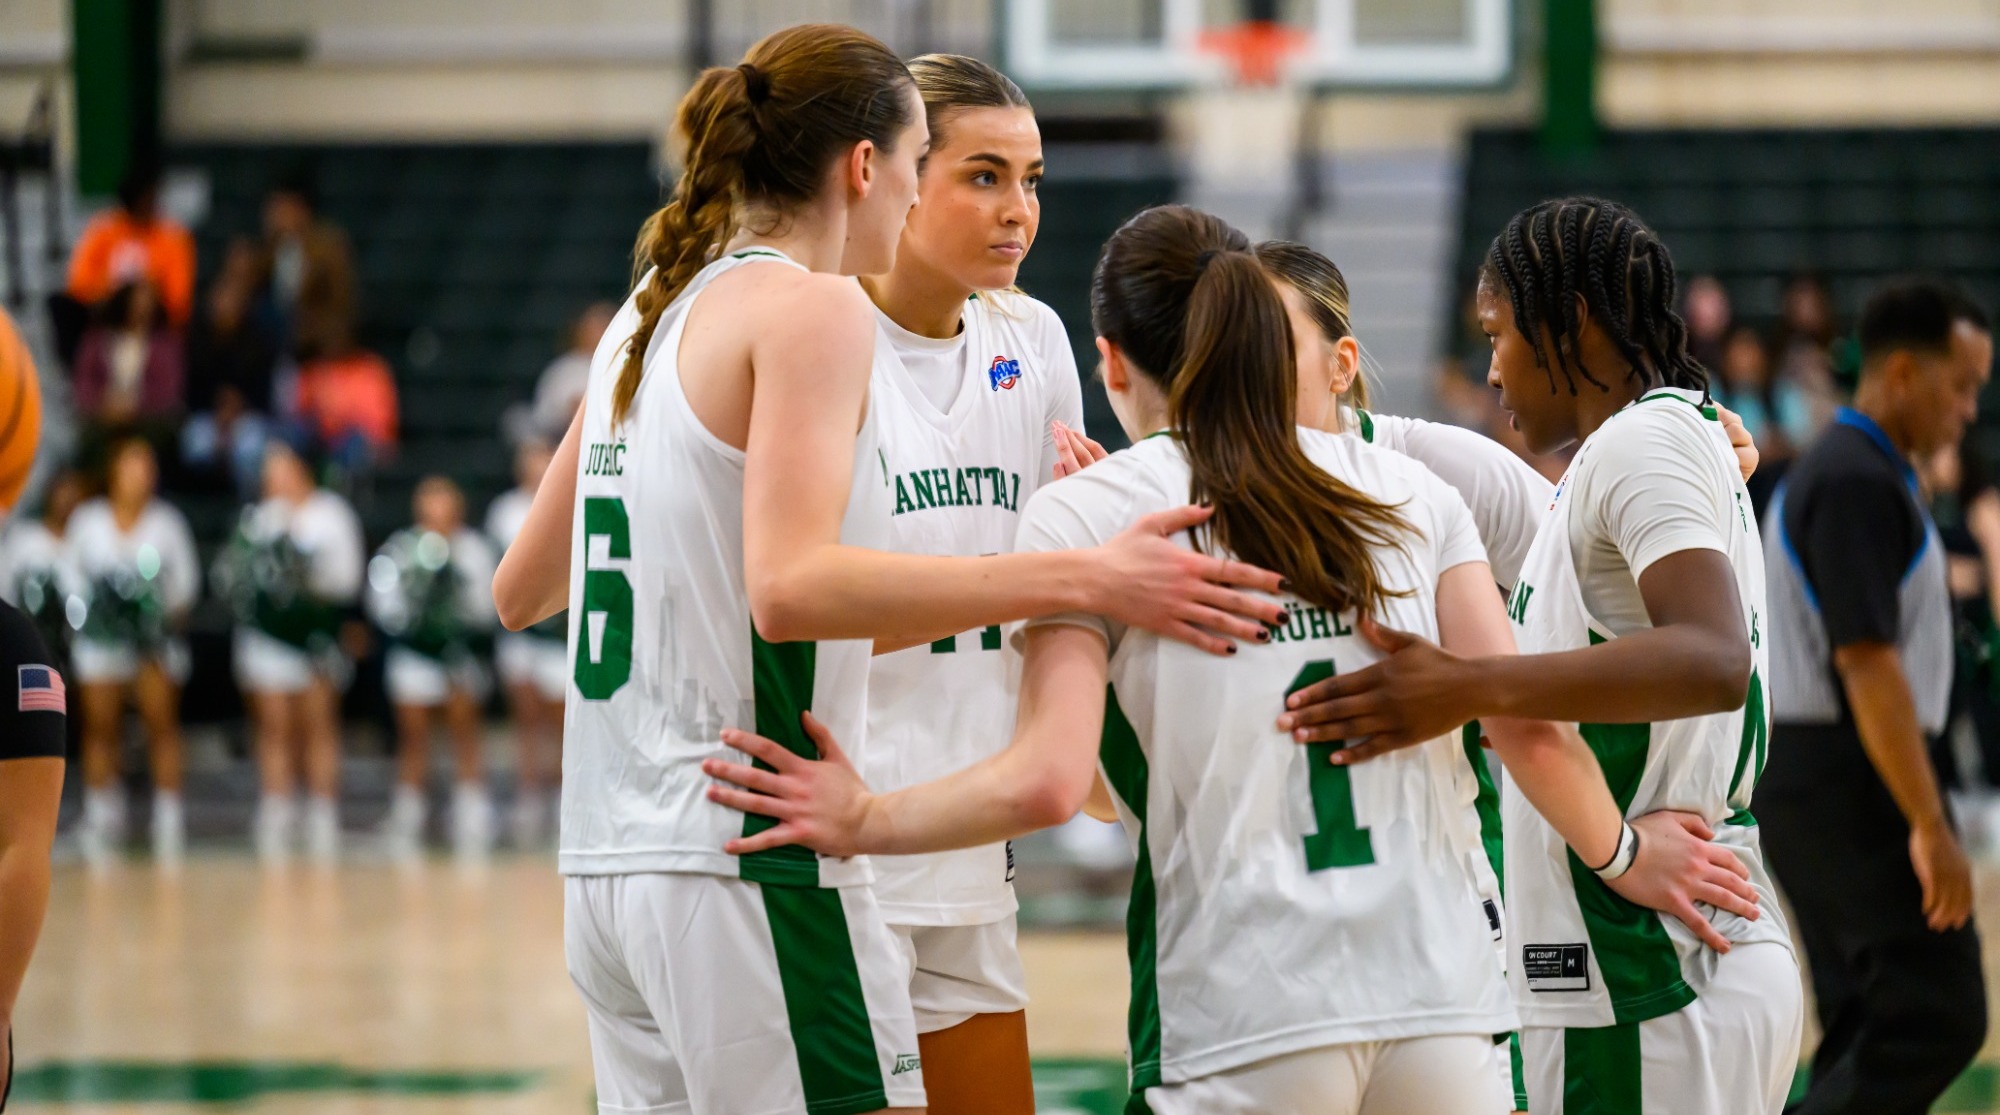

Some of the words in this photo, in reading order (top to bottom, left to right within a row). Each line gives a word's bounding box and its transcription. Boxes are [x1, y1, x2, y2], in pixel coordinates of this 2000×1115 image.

[892, 466, 1021, 516] ANHATTA
[574, 496, 633, 701] 6
[1284, 658, 1378, 873] 1
[1537, 951, 1557, 959] COURT
[1567, 959, 1575, 967] M
